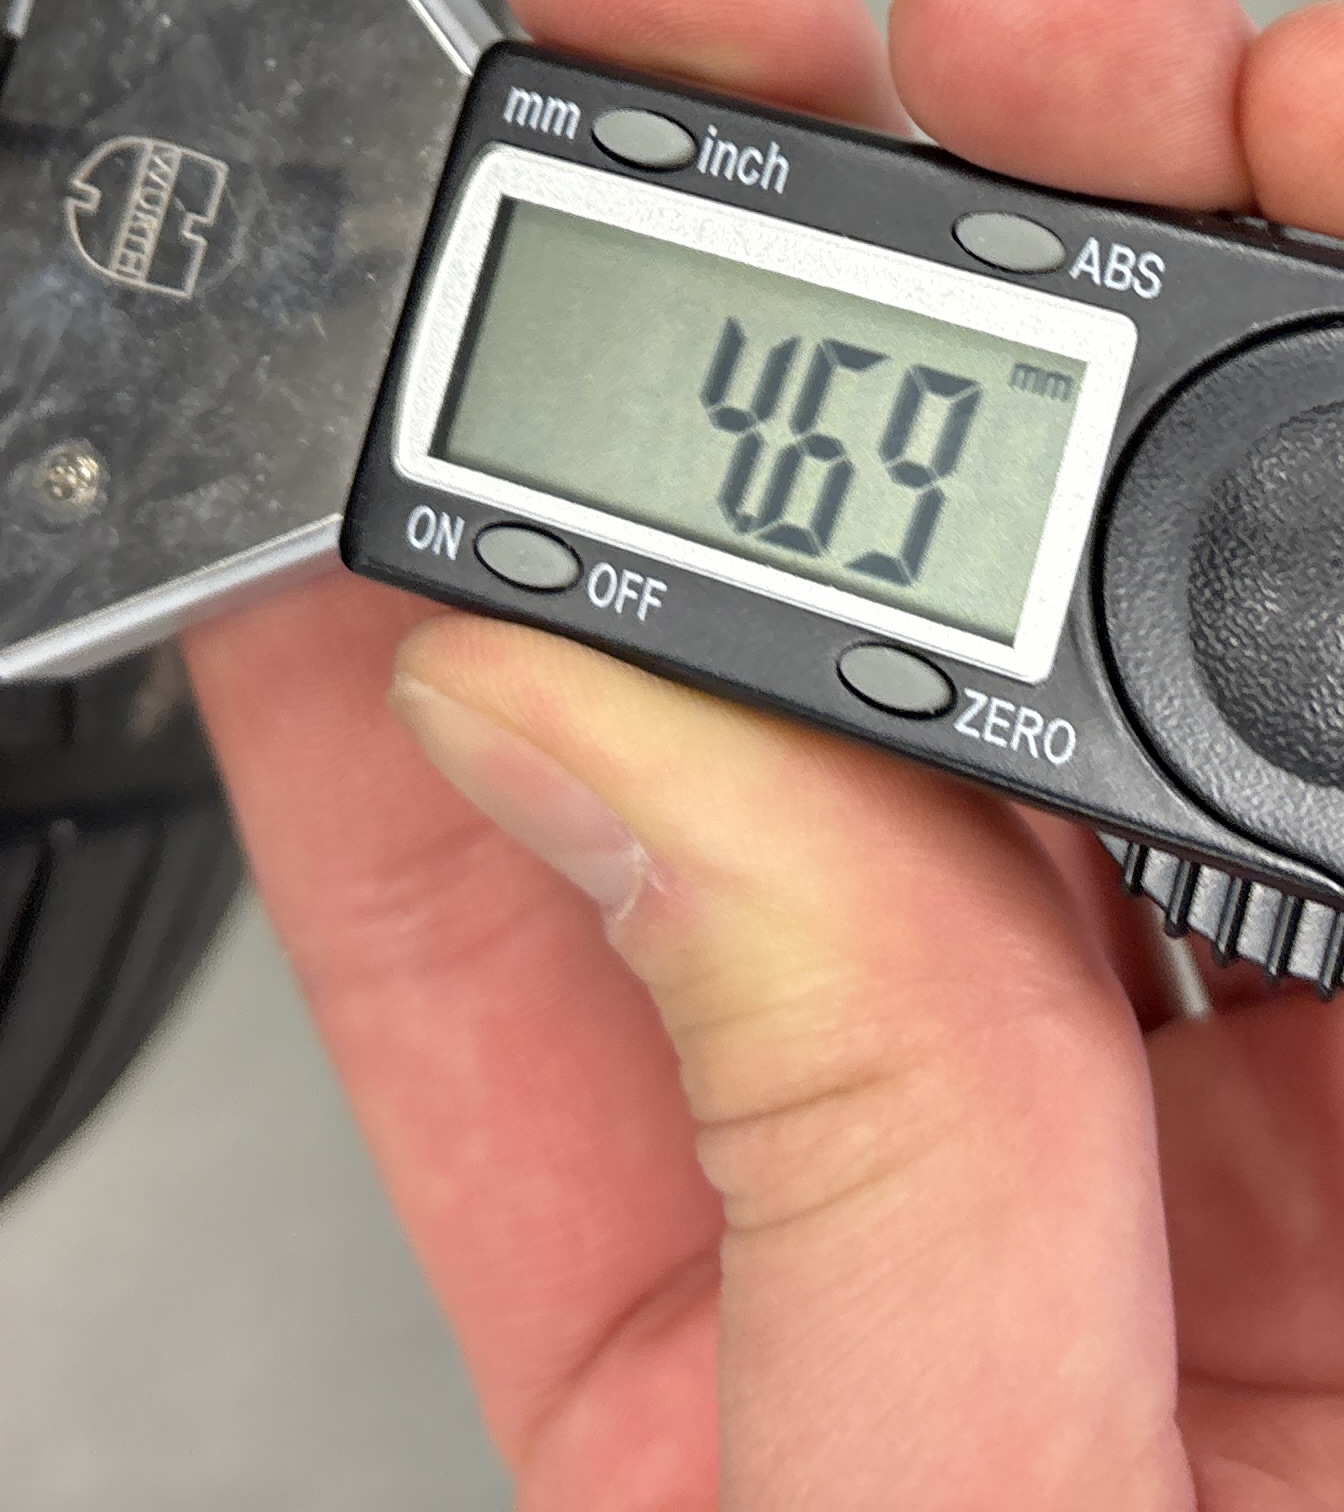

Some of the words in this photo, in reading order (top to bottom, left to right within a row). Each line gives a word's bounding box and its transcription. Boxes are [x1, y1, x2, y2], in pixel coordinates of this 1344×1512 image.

[503, 87, 580, 140] mm
[696, 126, 790, 193] inch
[1069, 236, 1166, 299] ABS
[1009, 362, 1075, 401] mm
[406, 504, 465, 560] ON
[586, 561, 668, 622] OFF
[954, 688, 1077, 765] ZERO
